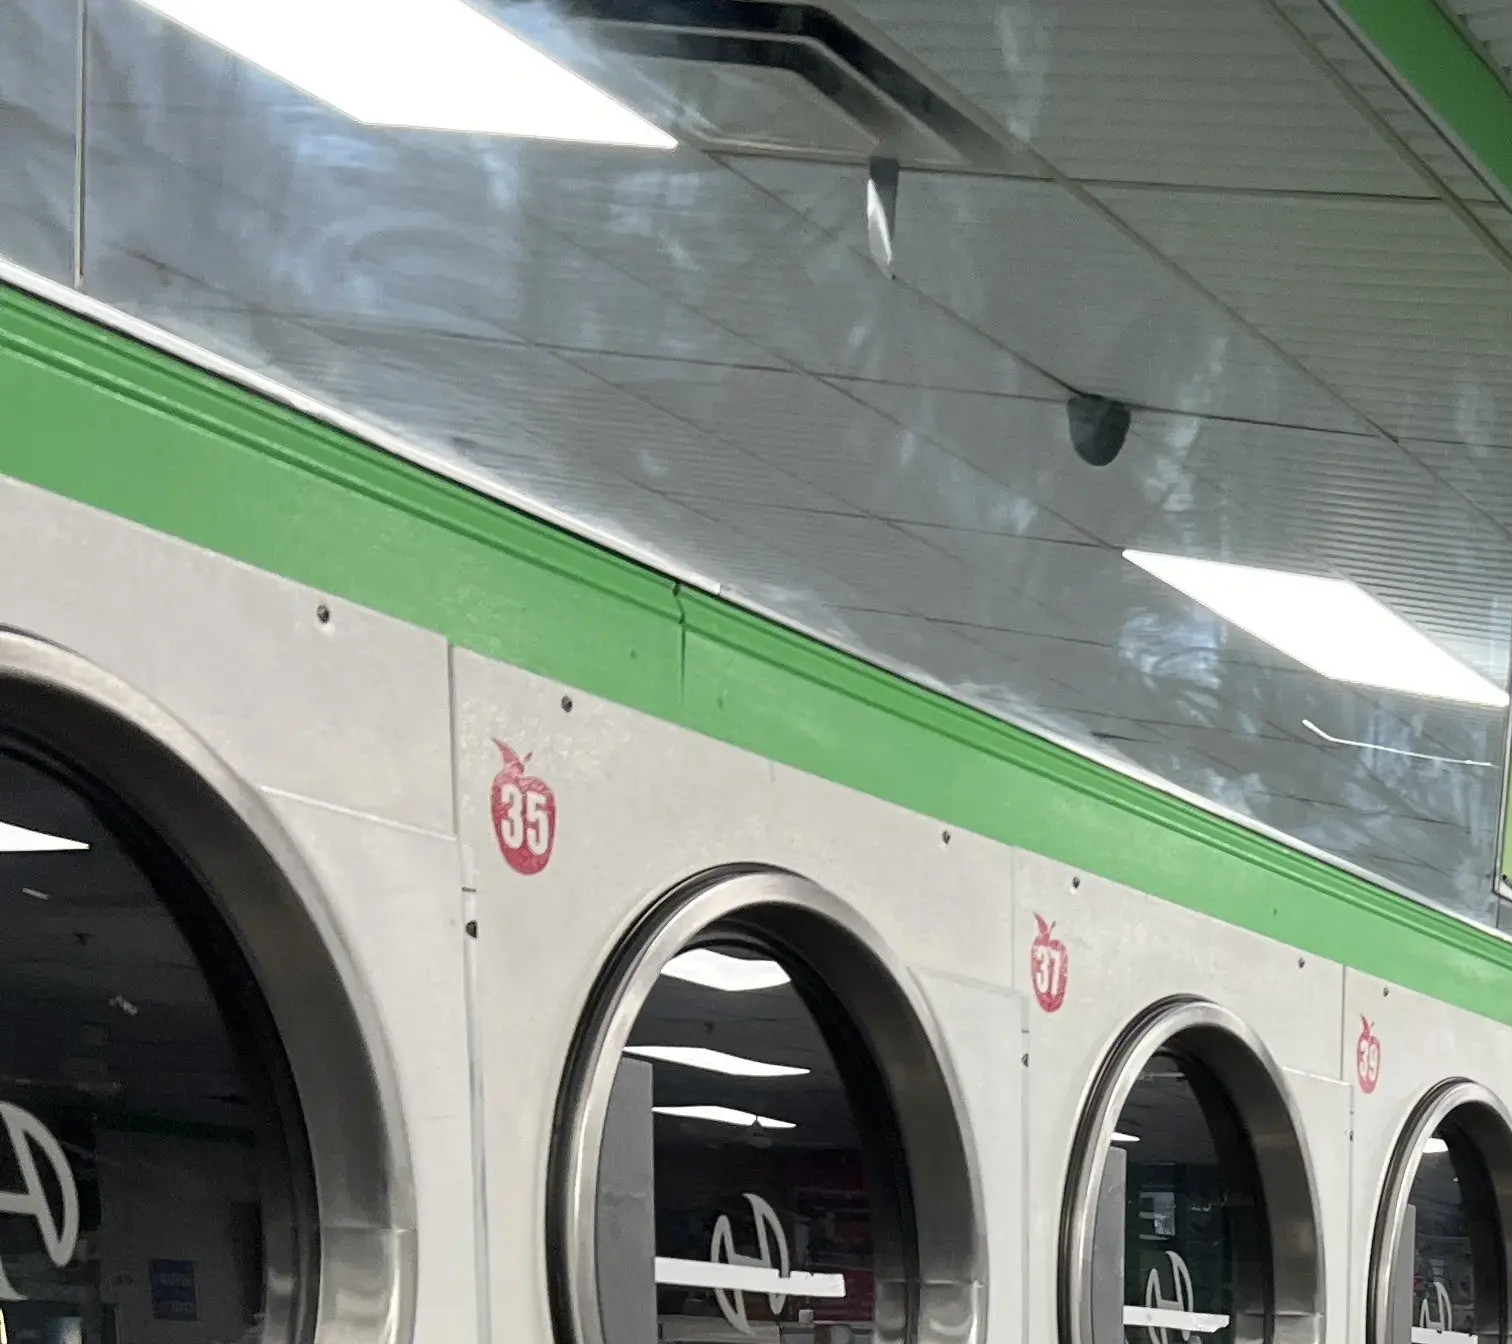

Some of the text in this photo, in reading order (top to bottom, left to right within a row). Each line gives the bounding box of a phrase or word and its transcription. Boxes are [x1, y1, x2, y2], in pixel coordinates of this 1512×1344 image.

[500, 784, 550, 857] 35
[1036, 944, 1062, 995] 37
[1360, 1039, 1379, 1082] 39
